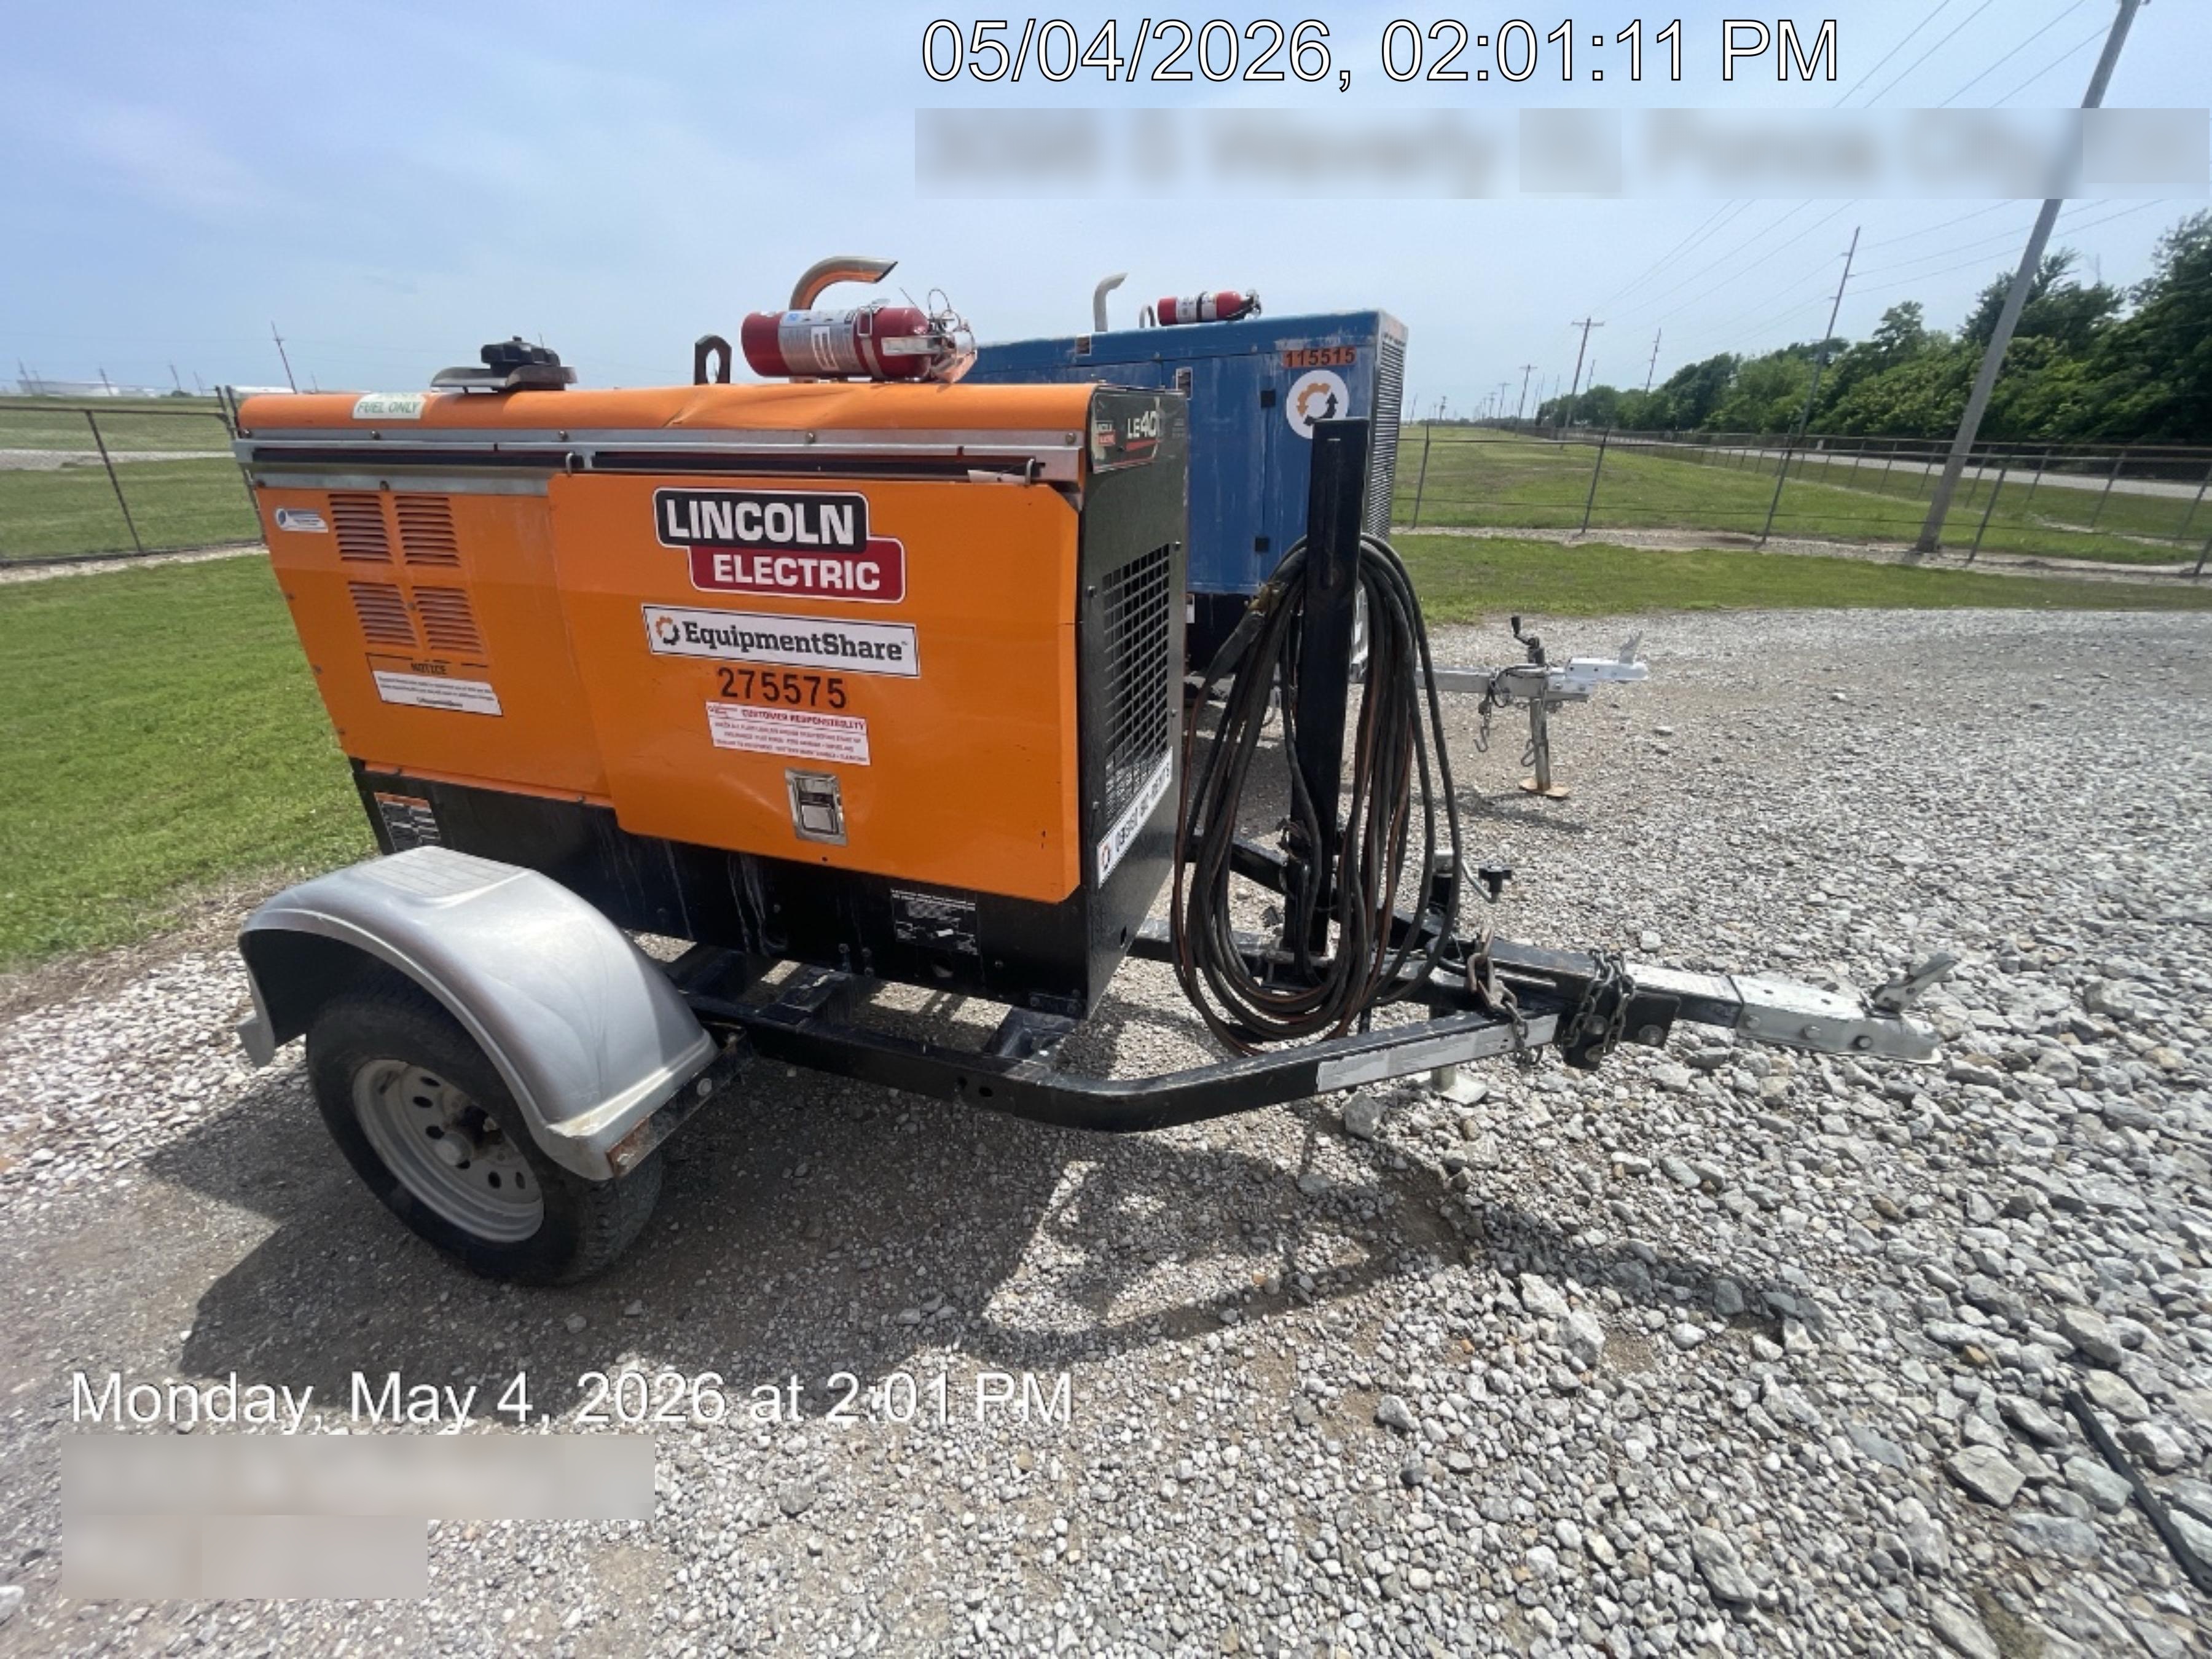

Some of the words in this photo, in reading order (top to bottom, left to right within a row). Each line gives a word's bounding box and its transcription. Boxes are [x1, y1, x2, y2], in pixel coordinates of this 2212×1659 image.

[1285, 348, 1356, 367] 115515
[358, 401, 384, 414] FUEL
[388, 401, 420, 414] ONLY
[665, 498, 855, 546] LINCOLN
[713, 554, 880, 591] ELECTRIC
[682, 621, 903, 661] EquipmentShare
[411, 662, 447, 675] NOTICE
[717, 667, 847, 709] 275575
[742, 708, 788, 721] CUSTOMER
[790, 714, 866, 731] RESPONSIBILITY
